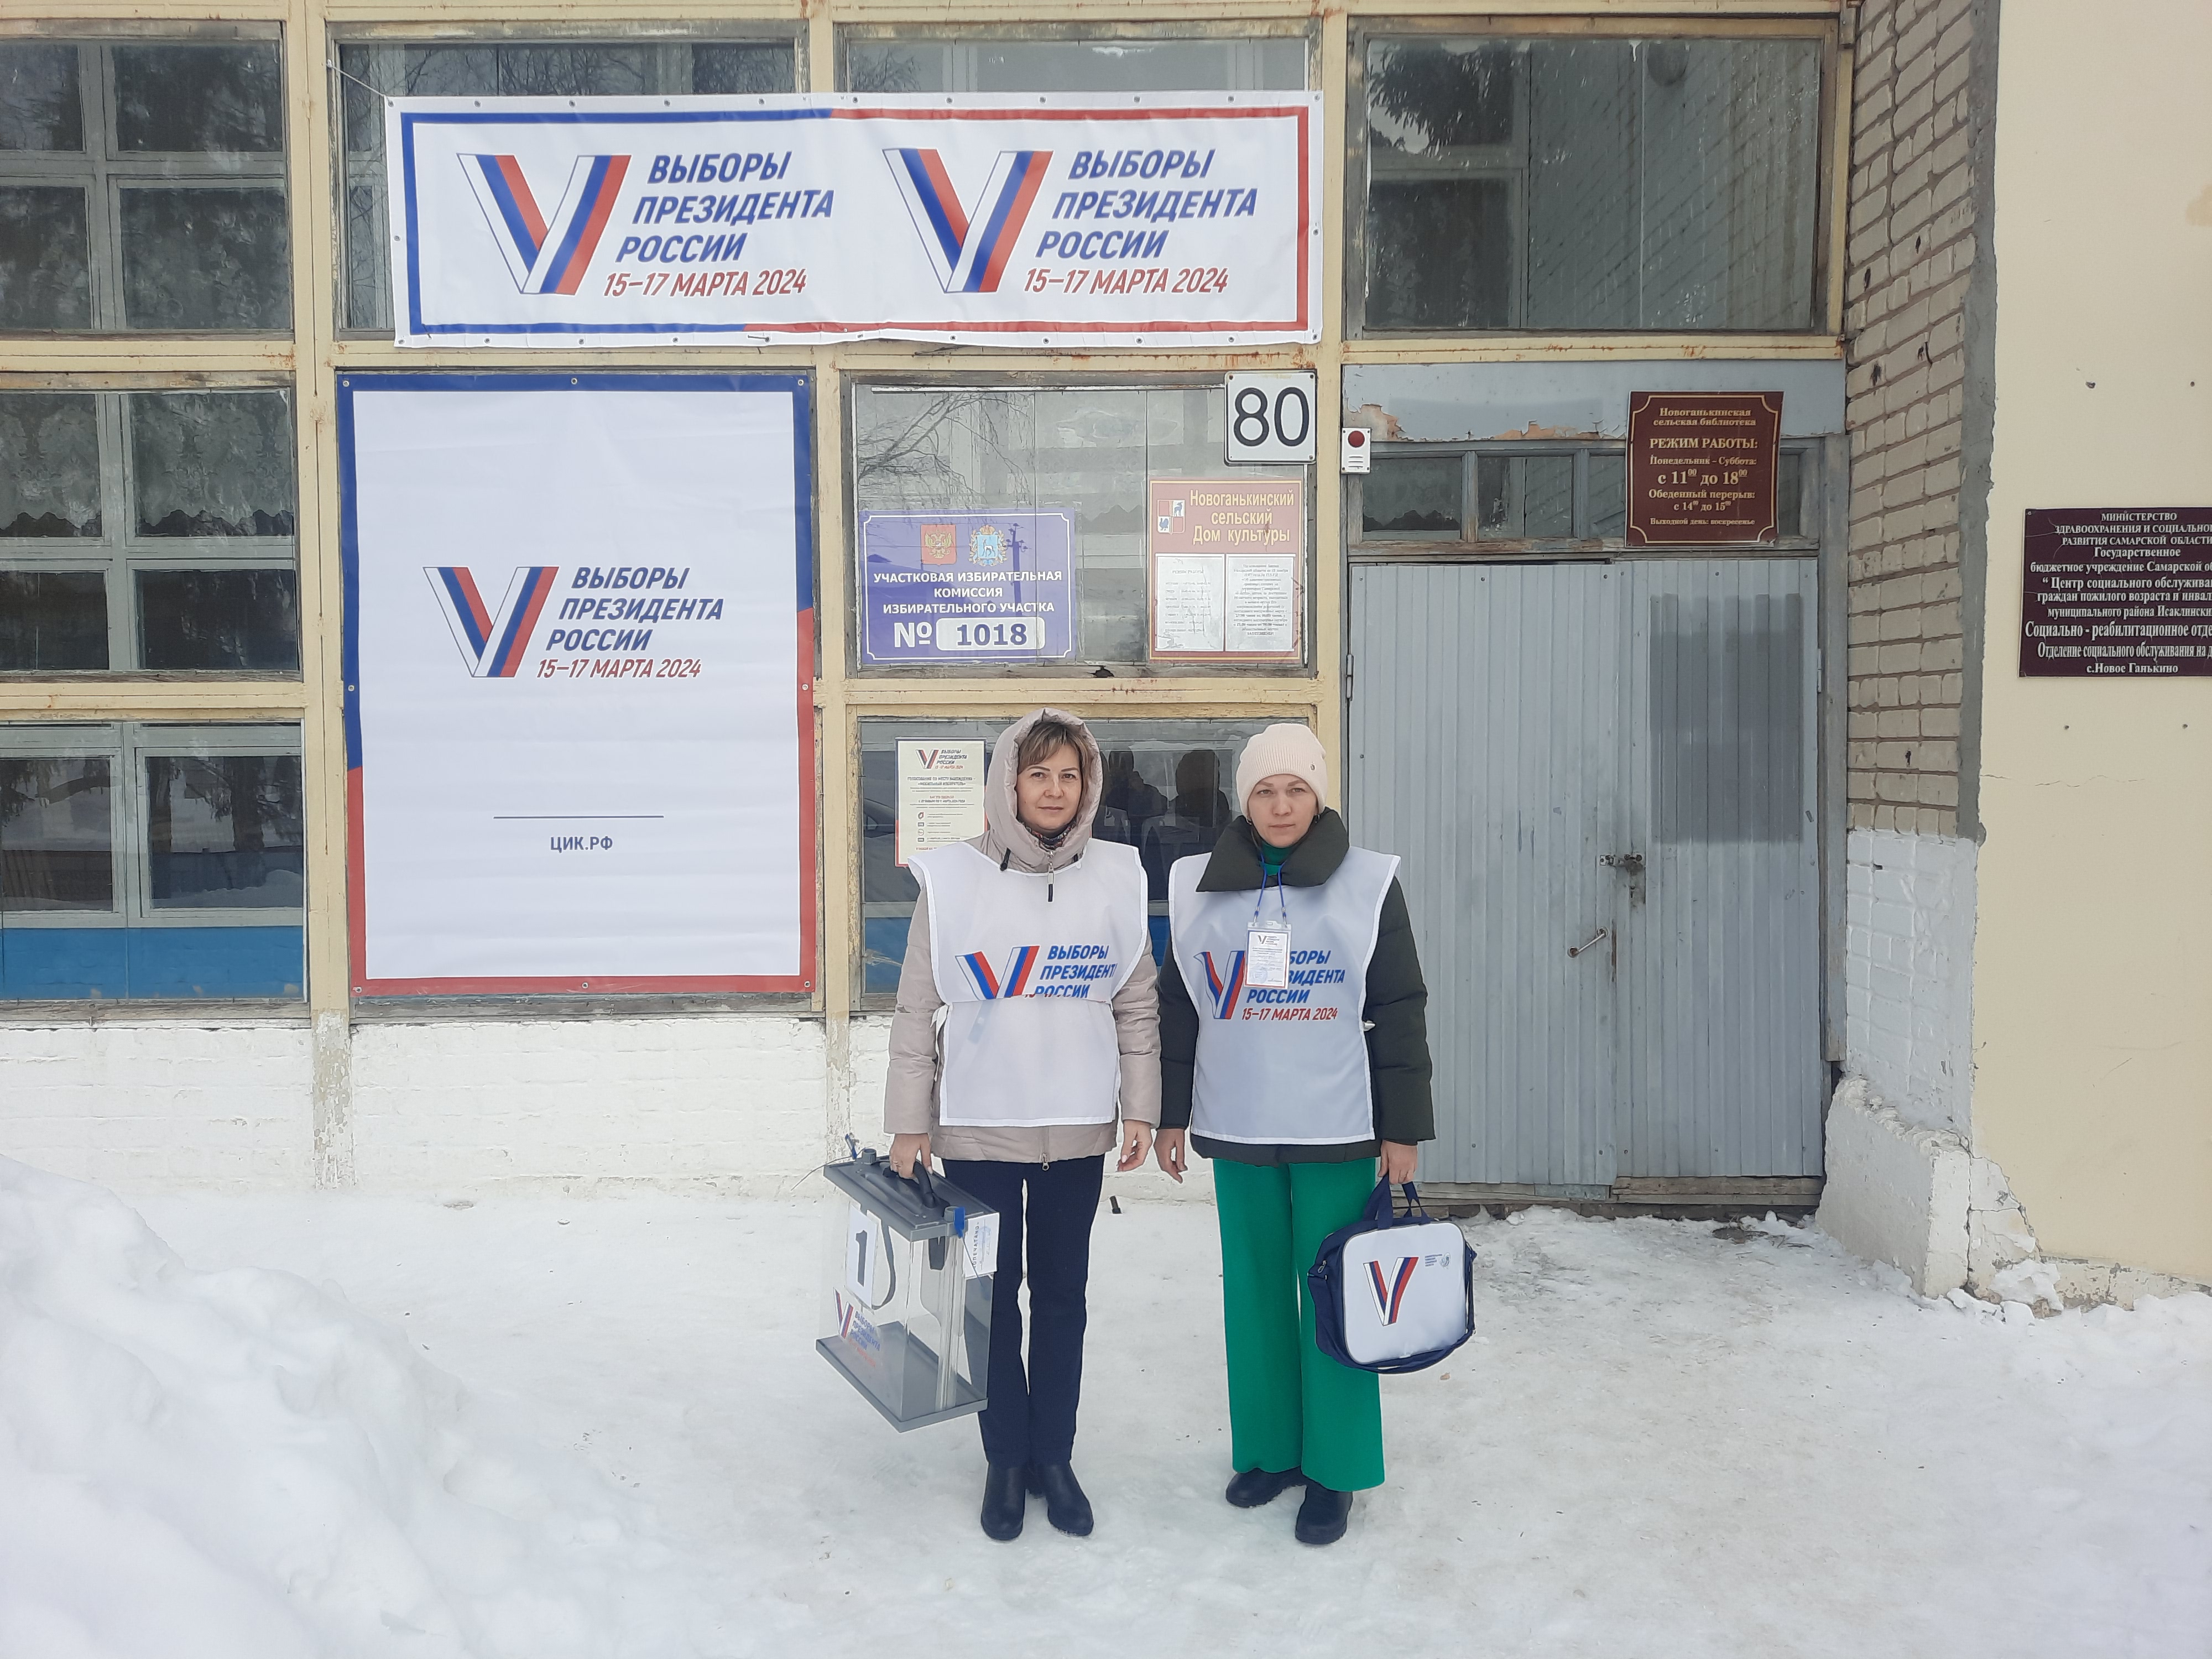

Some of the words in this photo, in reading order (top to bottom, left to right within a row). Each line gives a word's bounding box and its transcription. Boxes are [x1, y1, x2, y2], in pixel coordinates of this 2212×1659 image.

[648, 152, 791, 184] ВЫБОРЫ
[1067, 149, 1215, 180] ВЫБОРЫ
[632, 190, 834, 226] ПРЕЗИДЕНТА
[1052, 188, 1258, 222] ПРЕЗИДЕНТА
[616, 233, 747, 262] РОССИИ
[1036, 231, 1168, 259] РОССИИ
[671, 271, 748, 296] МАРТА
[753, 268, 806, 295] 2024
[1090, 268, 1170, 294] МАРТА
[1171, 267, 1228, 293] 2024
[1233, 387, 1310, 447] 80
[1660, 408, 1751, 416] Новоганькинская
[1700, 418, 1756, 426] библиотека
[1649, 438, 1698, 448] РЕЖИМ
[1702, 438, 1758, 448] РАБОТЫ:
[1650, 455, 1710, 465] Понедельник
[1719, 457, 1757, 466] Суббота:
[1658, 474, 1666, 484] с
[1700, 474, 1718, 486] до
[1190, 489, 1294, 507] Новоганькинский
[1648, 489, 1707, 498] Обеденный
[1710, 490, 1755, 500] перерыв:
[1700, 503, 1712, 512] до
[1211, 507, 1272, 524] сельский
[2101, 513, 2177, 521] МИНИСТЕРСТВО
[1193, 525, 1220, 545] Дом
[1228, 529, 1290, 546] культуры
[2055, 525, 2142, 534] ЗДРАВООХРАНЕНИЯ
[2062, 537, 2107, 545] РАЗВИТИЯ
[2109, 535, 2167, 545] САМАРСКОЙ
[2171, 536, 2212, 545] ОБЛАСТИ
[2094, 547, 2181, 559] Государственное
[2030, 562, 2084, 572] бюджетное
[2085, 564, 2145, 575] учреждение
[2147, 561, 2201, 574] Самарской
[571, 567, 690, 589] ВЫБОРЫ
[874, 572, 953, 583] УЧАСТКОВАЯ
[958, 571, 1062, 582] ИЗБИРАТЕЛЬНАЯ
[2086, 579, 2152, 592] социального
[2154, 577, 2212, 591] обслужива
[935, 588, 1003, 597] КОМИССИЯ
[2037, 592, 2077, 604] граждан
[2080, 592, 2126, 603] пожилого
[2129, 592, 2171, 604] возраста
[2173, 592, 2179, 601] и
[559, 598, 724, 623] ПРЕЗИДЕНТА
[883, 603, 996, 614] ИЗБИРАТЕЛЬНОГО
[1000, 602, 1054, 612] УЧАСТКА
[2048, 607, 2121, 619] муниципального
[2123, 606, 2154, 620] района
[957, 623, 1027, 645] 1018
[2025, 620, 2083, 640] Социально
[2092, 621, 2188, 641] реабилитационное
[546, 629, 653, 651] РОССИИ
[2038, 642, 2081, 661] Отделение
[2083, 645, 2134, 662] социального
[2136, 641, 2194, 663] обслуживания
[2196, 645, 2206, 657] на
[589, 659, 651, 677] МАРТА
[655, 659, 702, 677] 2024
[2128, 662, 2178, 673] Ганькино
[550, 836, 613, 853] ЦИК.РФ
[1047, 945, 1109, 960] ВЫБОРЫ
[1290, 951, 1331, 964] БОРЫ
[1040, 963, 1118, 981] ПРЕЗИДЕНТ
[1289, 970, 1345, 986] ЗИДЕНТА
[1035, 984, 1090, 998] РОССИИ
[1246, 989, 1311, 1003] РОССИИ
[1272, 1009, 1311, 1020] МАРТА
[1312, 1008, 1338, 1020] 2024
[855, 1230, 867, 1287] 1
[855, 1311, 874, 1333] ВЫБОРЫ
